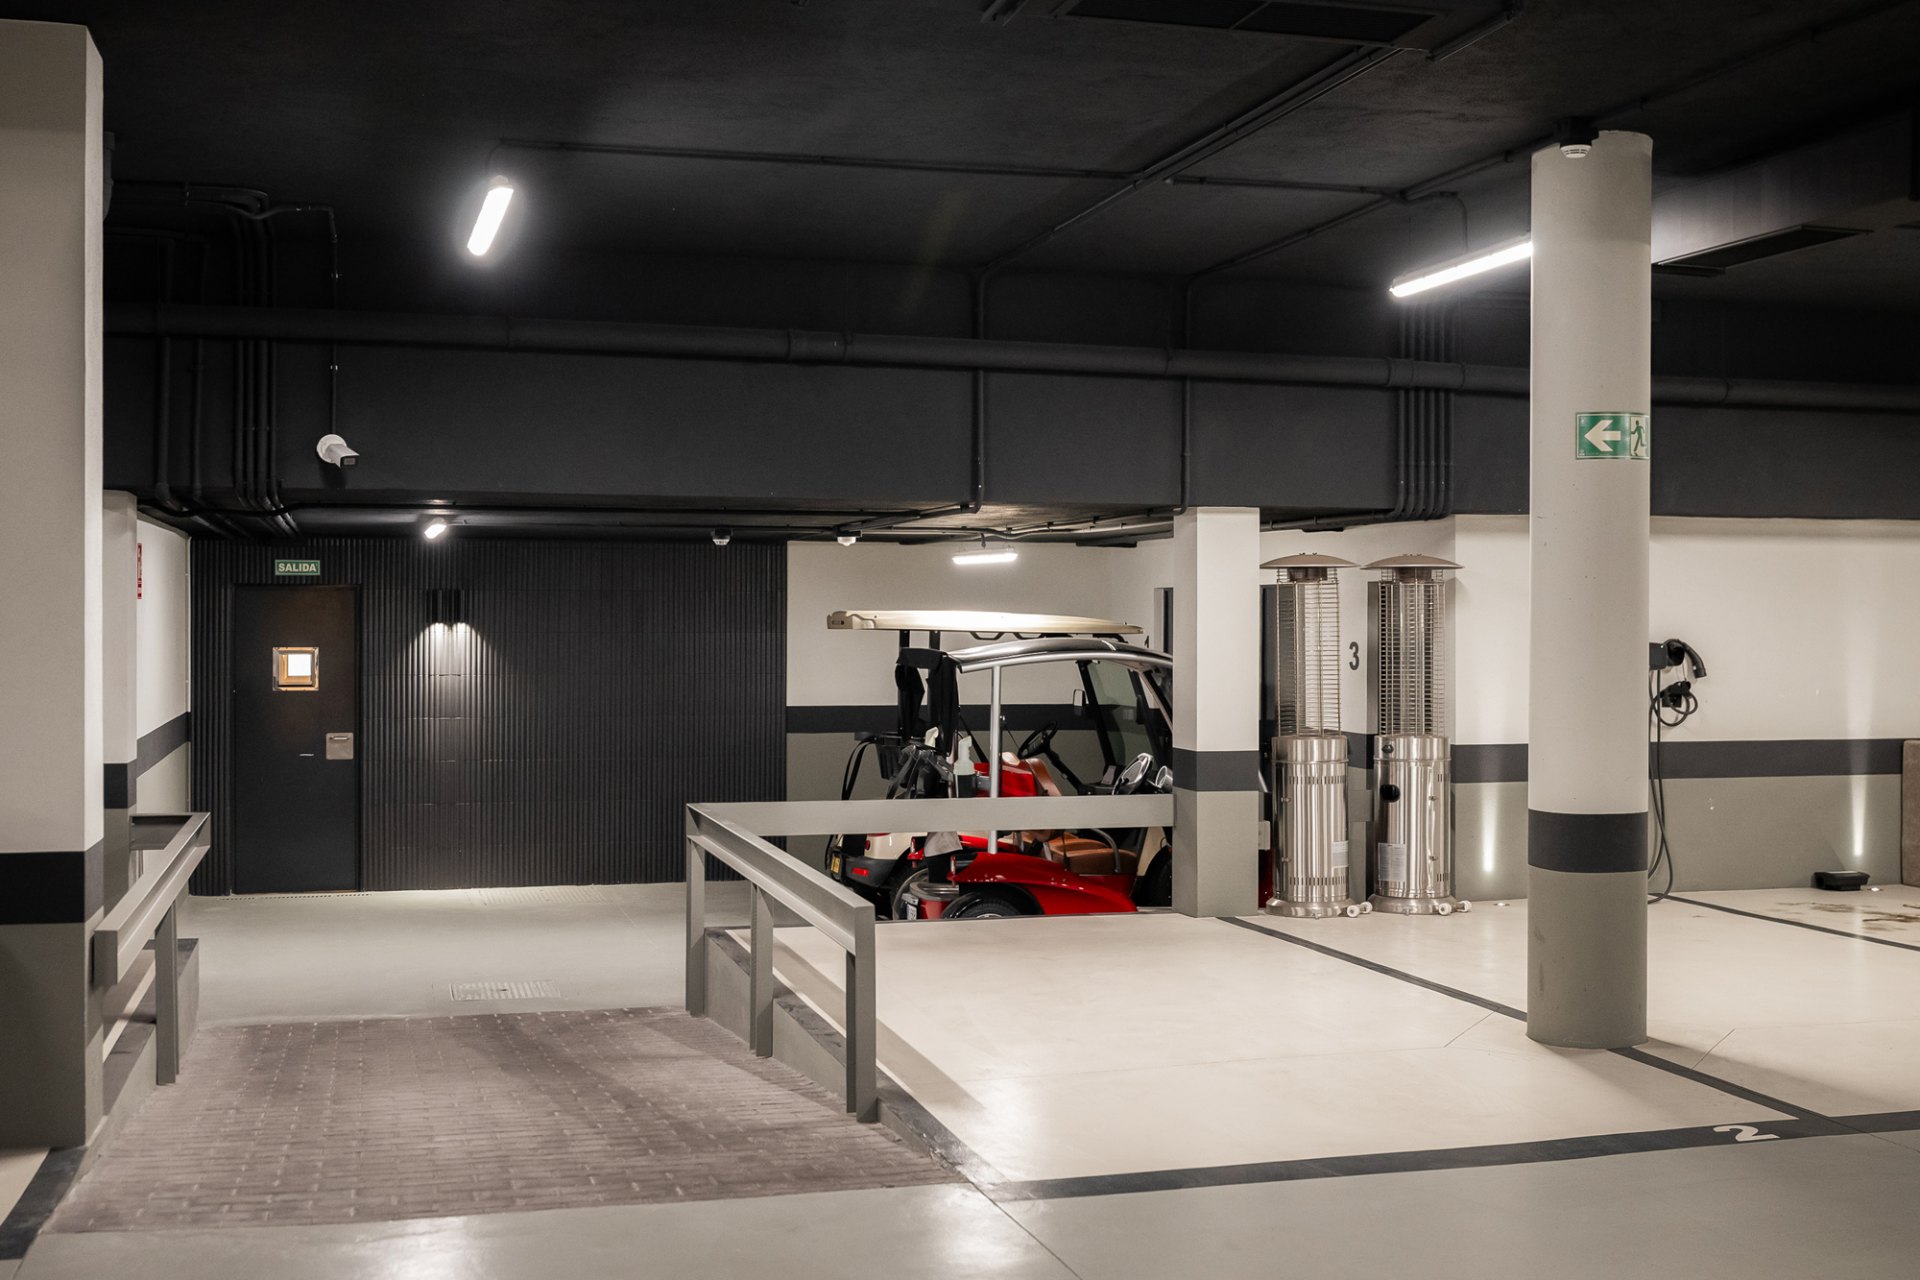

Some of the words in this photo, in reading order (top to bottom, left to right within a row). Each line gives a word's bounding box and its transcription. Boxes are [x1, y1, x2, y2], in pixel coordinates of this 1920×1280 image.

[278, 562, 317, 572] SALIDA
[1349, 641, 1360, 671] 3
[1713, 1124, 1780, 1142] 2
